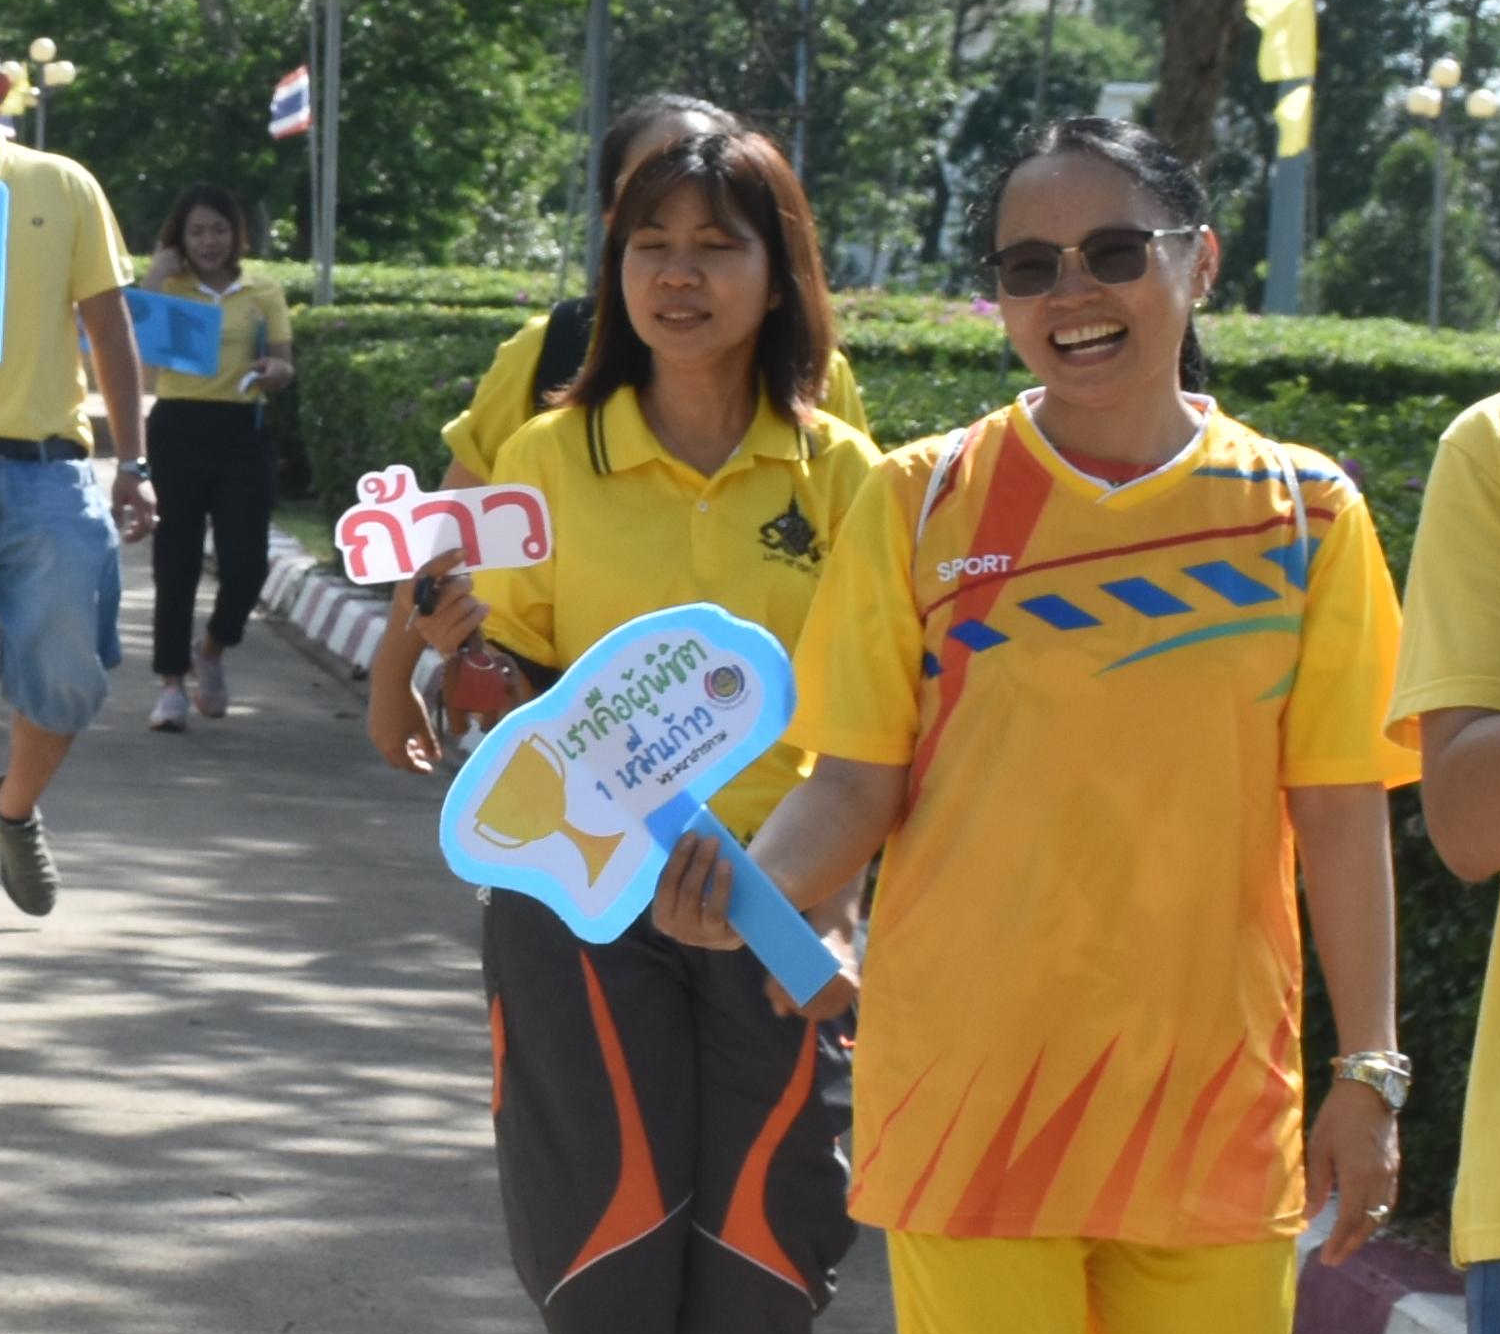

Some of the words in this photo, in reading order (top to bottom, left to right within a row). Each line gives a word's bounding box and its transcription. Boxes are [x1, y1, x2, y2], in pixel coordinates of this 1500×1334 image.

[340, 472, 549, 578] ก้าว
[936, 553, 1013, 583] SPORT
[556, 637, 709, 761] เราคือผู้พิชิต
[595, 779, 615, 801] 1
[614, 704, 714, 790] หมื่นก้าว
